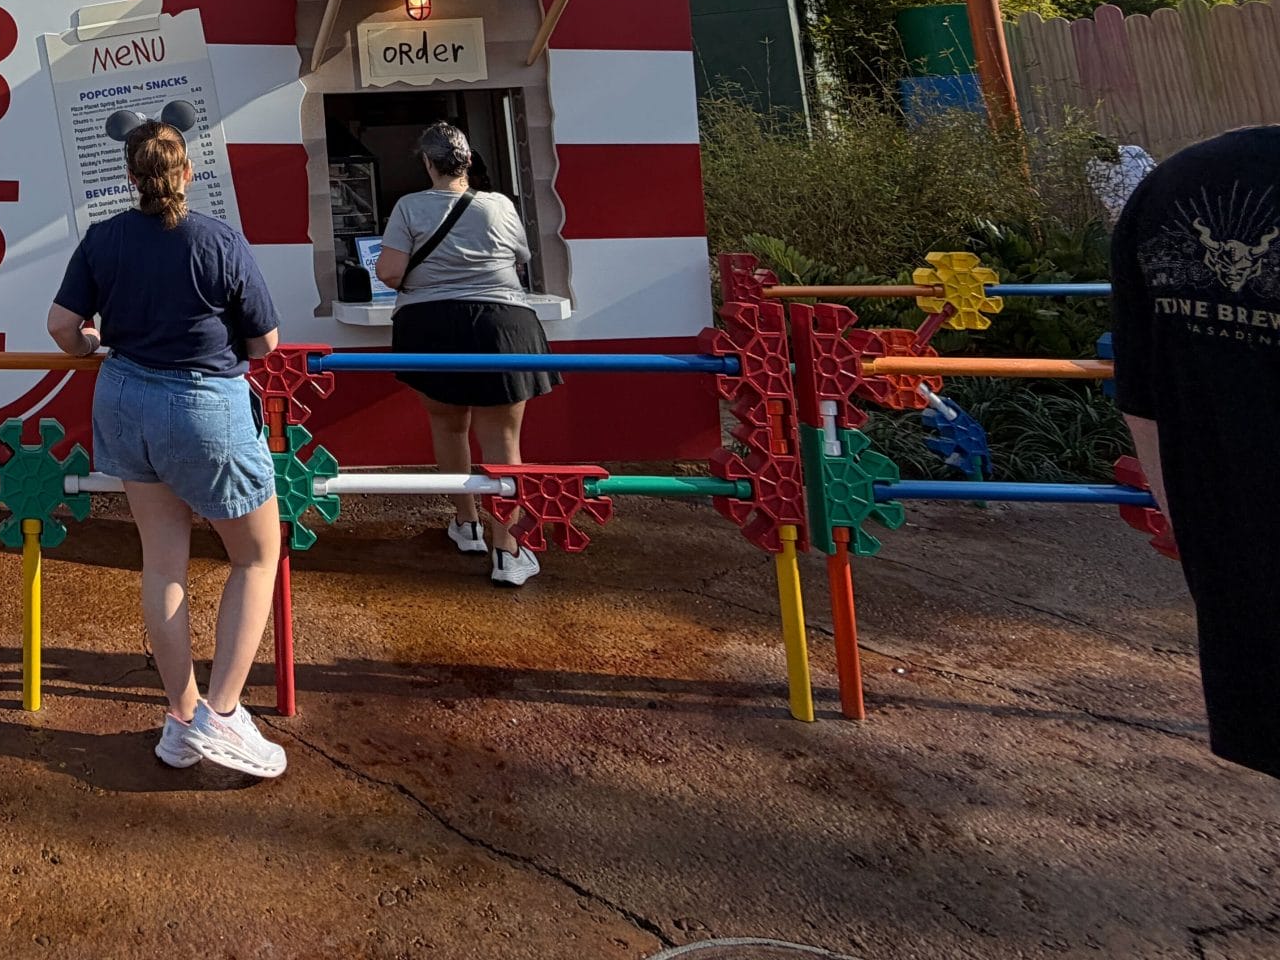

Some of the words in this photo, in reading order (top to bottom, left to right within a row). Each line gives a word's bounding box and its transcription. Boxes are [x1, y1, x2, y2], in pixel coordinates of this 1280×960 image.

[79, 86, 131, 101] POPCORN
[145, 75, 188, 91] SNACKS
[85, 185, 136, 199] BEVERAG
[1216, 303, 1280, 330] BREW
